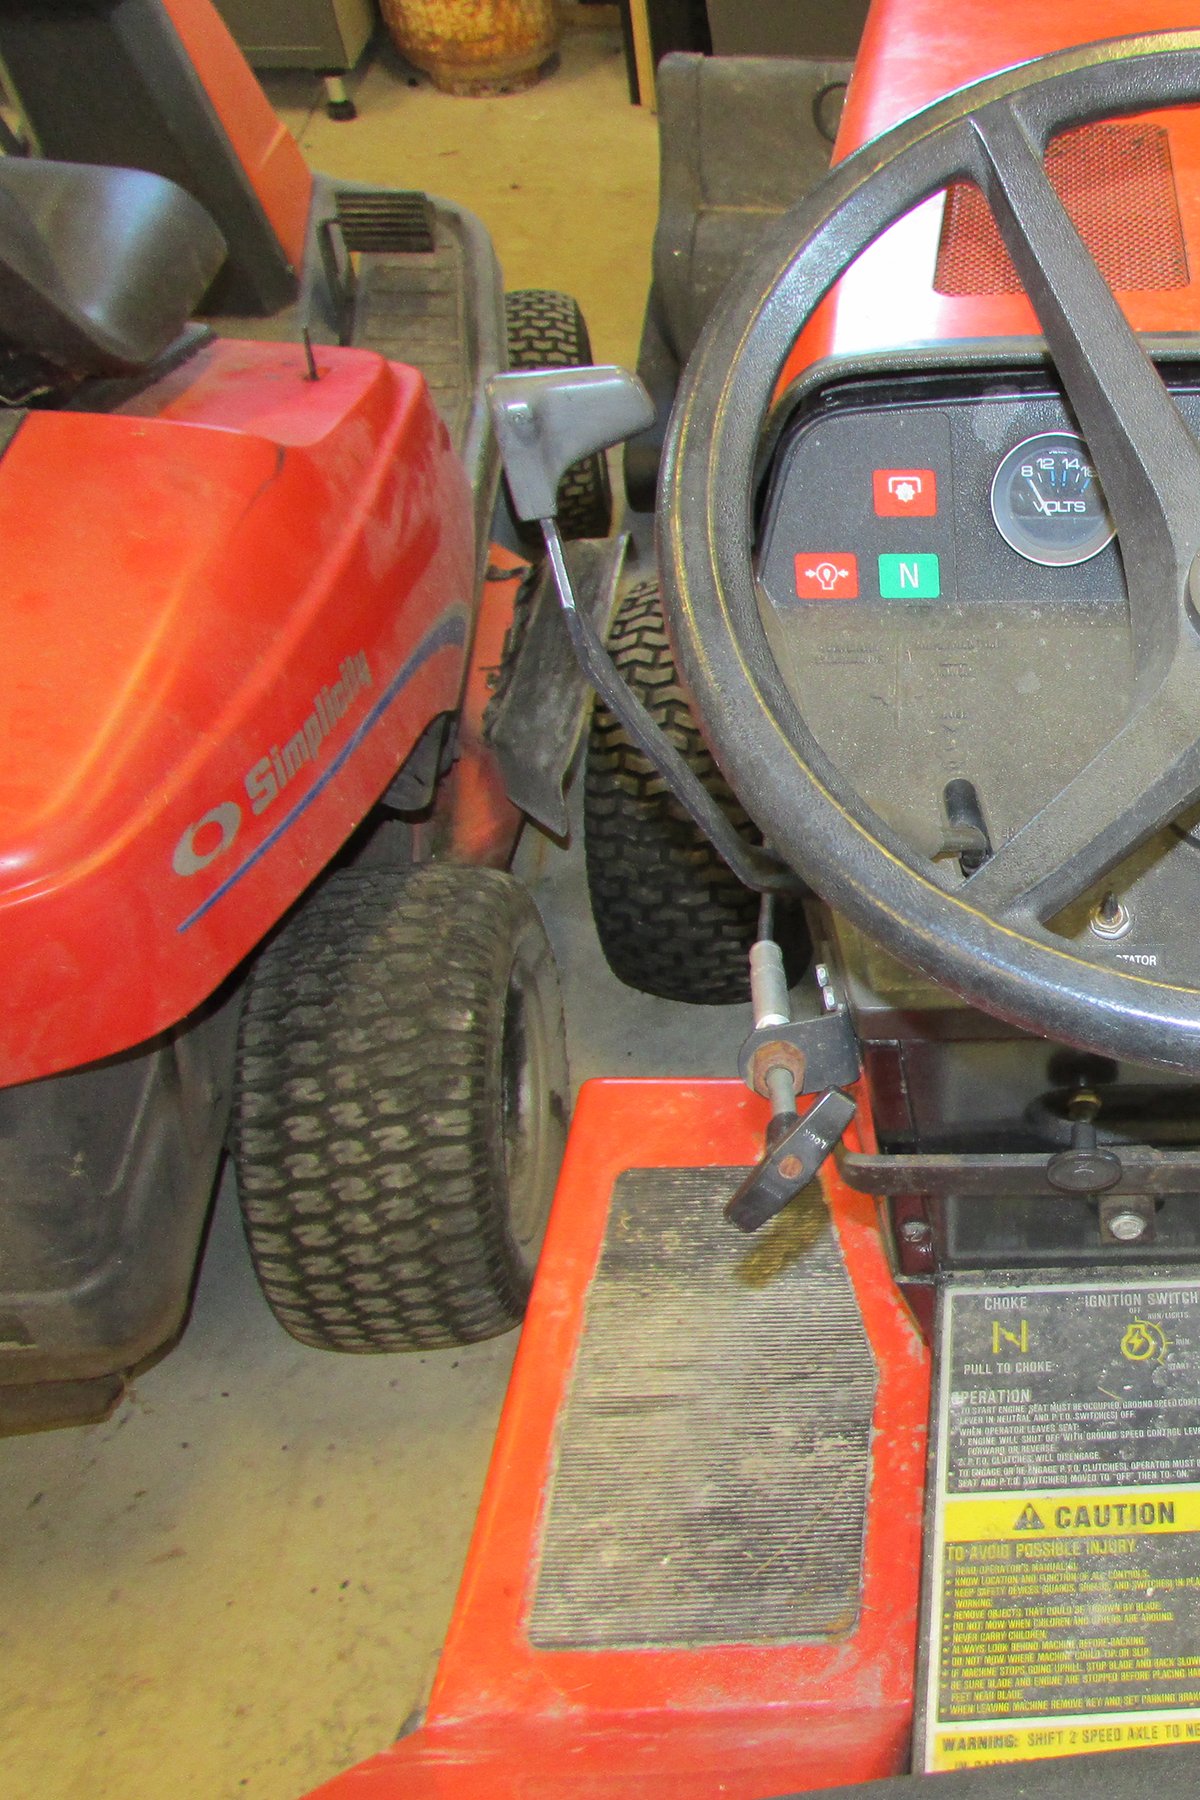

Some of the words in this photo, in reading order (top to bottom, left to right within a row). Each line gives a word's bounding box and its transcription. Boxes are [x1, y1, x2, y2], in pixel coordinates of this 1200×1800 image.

[1021, 465, 1034, 477] 8
[1037, 458, 1054, 470] 12
[1062, 458, 1080, 470] 14
[1033, 501, 1086, 513] VOLTS
[899, 562, 919, 589] N
[244, 649, 373, 816] Simplicity
[984, 1296, 1027, 1311] CHOKE
[1085, 1294, 1141, 1308] IGNITION
[1147, 1291, 1198, 1305] SWITCH
[964, 1364, 993, 1375] PULL
[996, 1362, 1011, 1374] TO
[1015, 1361, 1052, 1373] CHOKE
[972, 1405, 996, 1414] START
[999, 1404, 1025, 1414] ENGINE
[1050, 1402, 1072, 1412] MUST
[1123, 1400, 1153, 1409] GROUND
[1154, 1399, 1177, 1408] SPEED
[986, 1415, 994, 1424] IN
[984, 1426, 1024, 1435] OPERATOR
[1027, 1424, 1056, 1433] LEAVES
[999, 1436, 1017, 1445] WILL
[1120, 1430, 1144, 1439] SPEED
[1146, 1428, 1181, 1437] CONTROL
[1130, 1460, 1170, 1470] OPERATOR
[1070, 1472, 1097, 1483] MOVED
[1100, 1472, 1110, 1482] TO
[1161, 1470, 1171, 1479] TO
[1055, 1502, 1175, 1528] CAUTION
[946, 1546, 965, 1562] TO
[970, 1544, 1009, 1560] AVOID
[1016, 1541, 1082, 1559] POSSIBLE
[942, 1735, 1019, 1752] WARNING:
[1026, 1732, 1064, 1748] SHIFT
[1068, 1731, 1077, 1746] 2
[1082, 1728, 1122, 1744] SPEED
[1126, 1726, 1158, 1742] AXLE
[1164, 1724, 1180, 1738] TO
